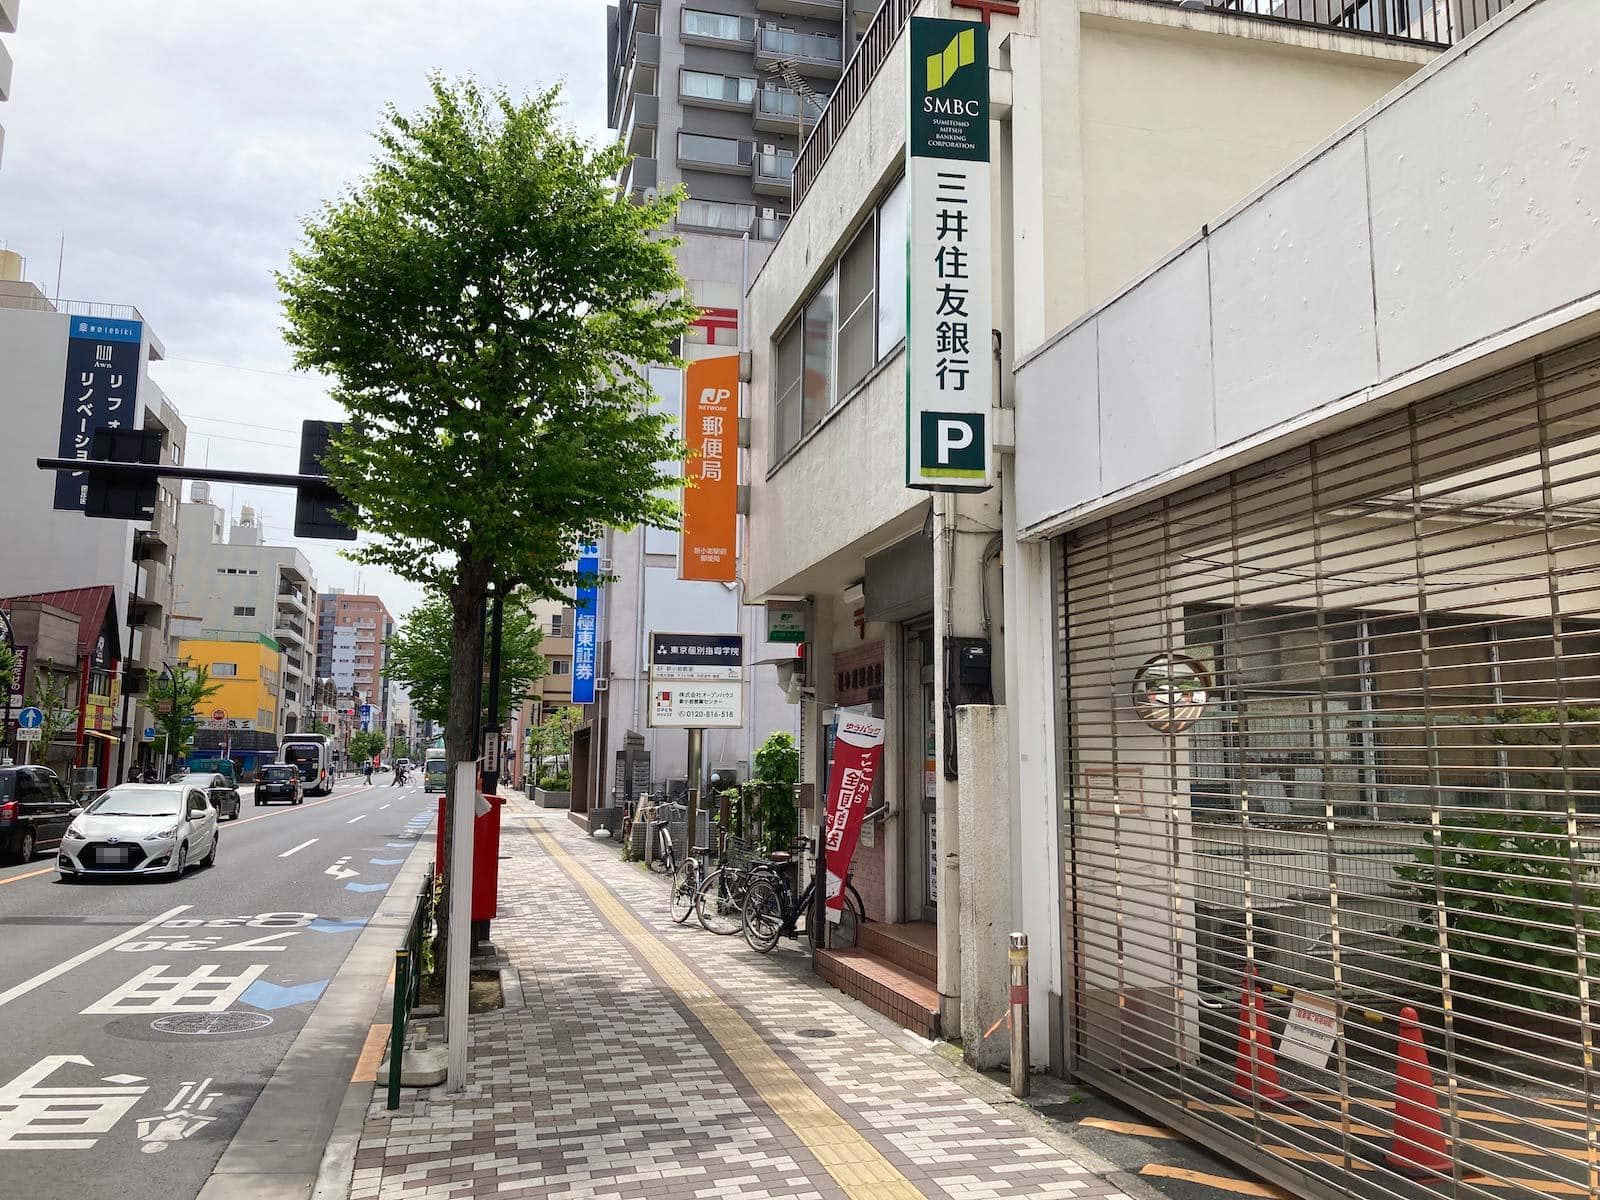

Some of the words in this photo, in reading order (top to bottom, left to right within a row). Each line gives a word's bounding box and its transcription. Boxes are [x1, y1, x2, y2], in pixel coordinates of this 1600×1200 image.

[923, 96, 979, 117] SMBC
[933, 118, 970, 128] SUMITOMO
[939, 126, 963, 134] MITSUI
[927, 140, 975, 150] CORPORATION
[935, 133, 967, 142] BANKING
[934, 172, 970, 392] 三井住友銀行
[698, 404, 728, 412] NETWORK
[700, 415, 724, 482] 郵便局
[937, 419, 974, 465] P
[575, 614, 595, 681] 極東証券
